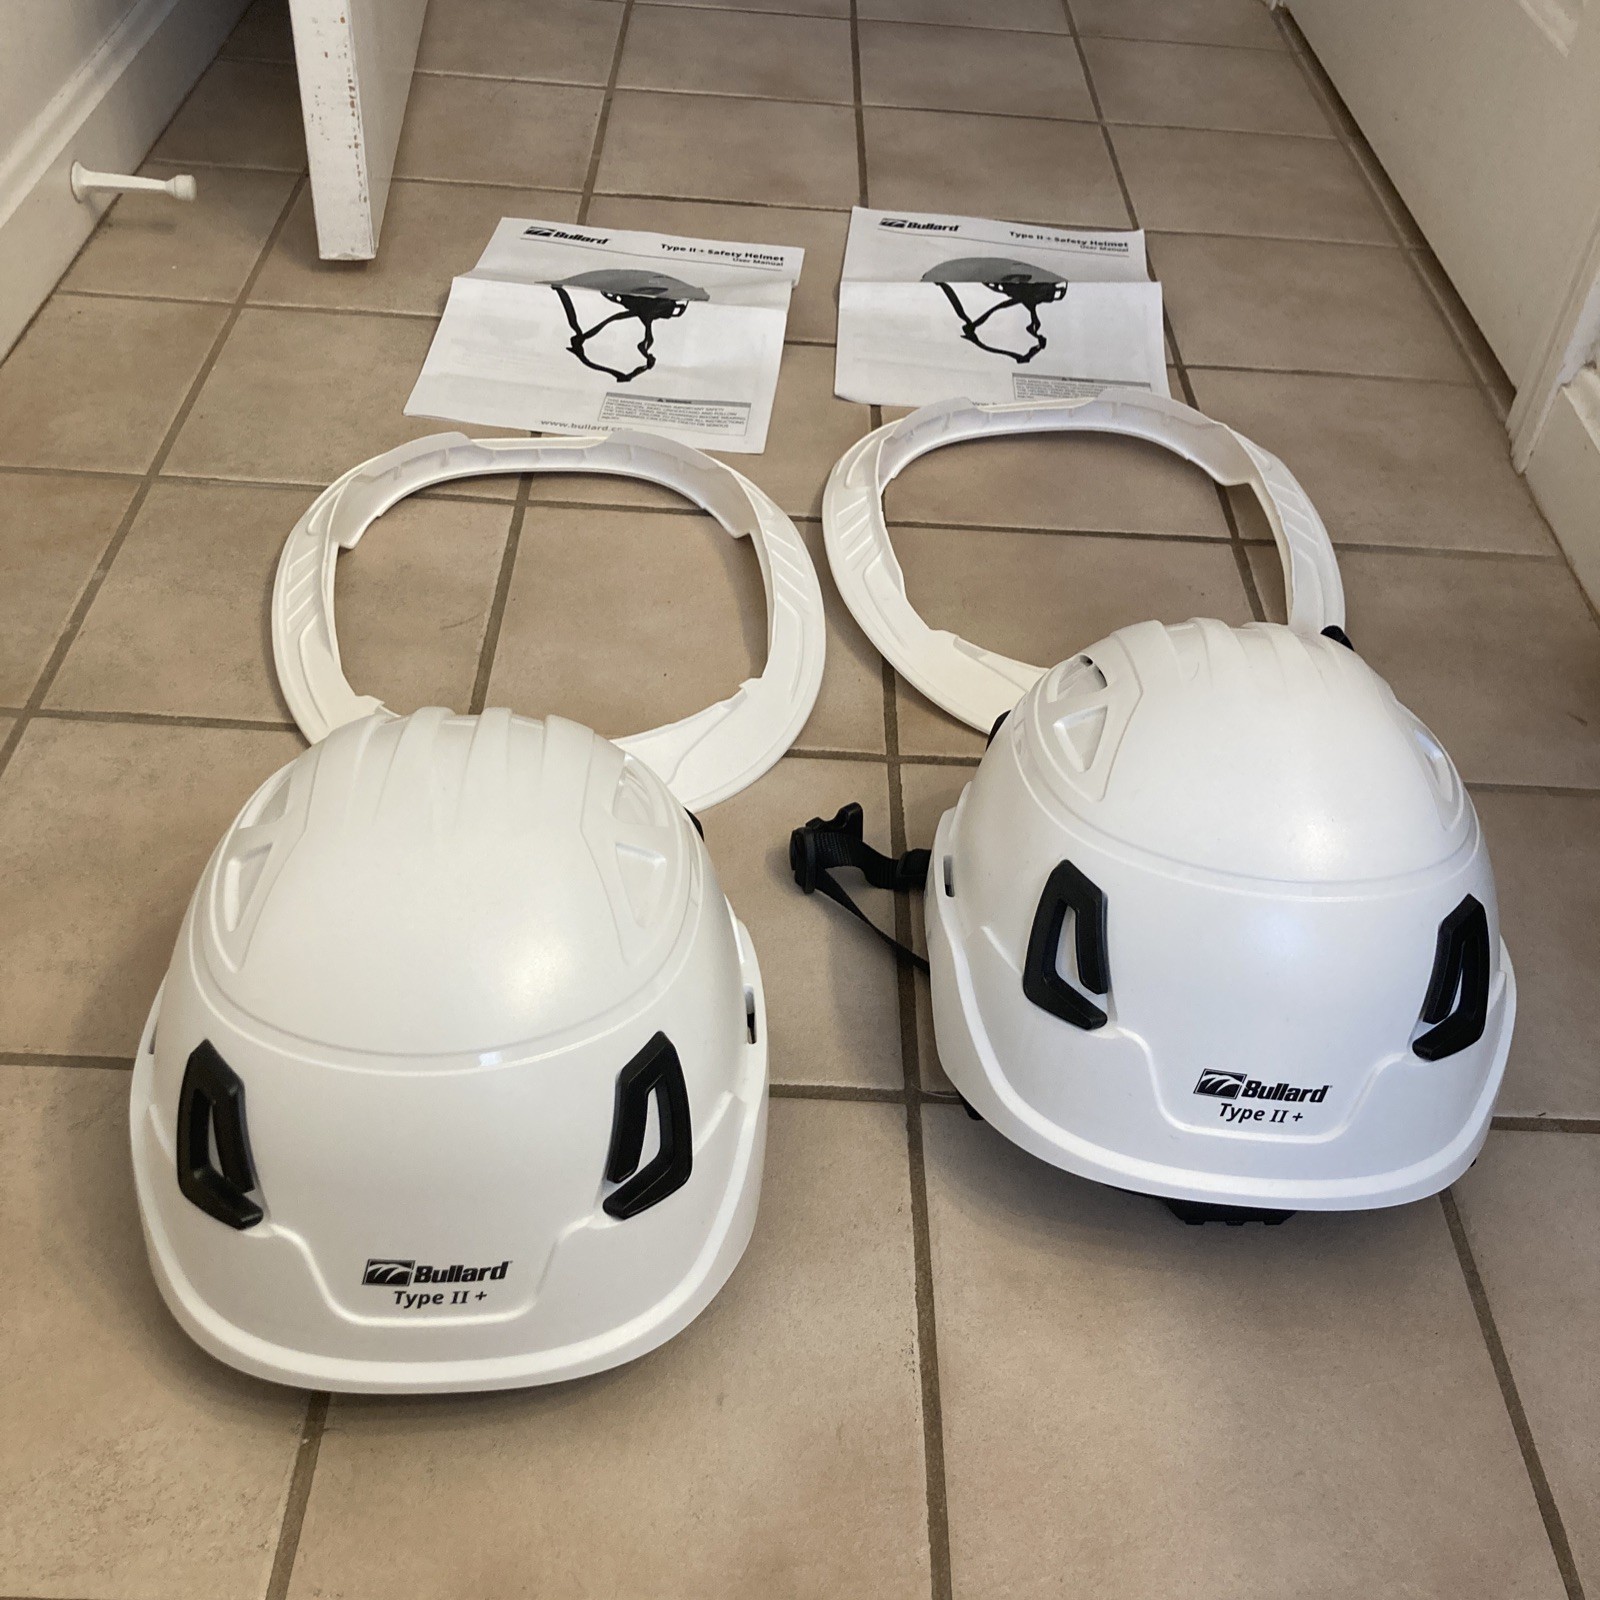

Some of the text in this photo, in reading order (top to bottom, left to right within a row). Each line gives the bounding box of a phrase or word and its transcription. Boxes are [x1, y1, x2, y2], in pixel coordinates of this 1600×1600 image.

[907, 222, 960, 232] Bullard
[553, 231, 609, 245] Bullard
[1009, 231, 1034, 239] Type
[1054, 237, 1087, 246] Safety
[661, 243, 686, 252] Type
[708, 249, 741, 258] Safety
[745, 252, 784, 261] Helmet
[1241, 1080, 1333, 1103] Bullard
[1219, 1102, 1265, 1123] Type
[413, 1260, 513, 1283] Bullard
[394, 1290, 444, 1309] Type
